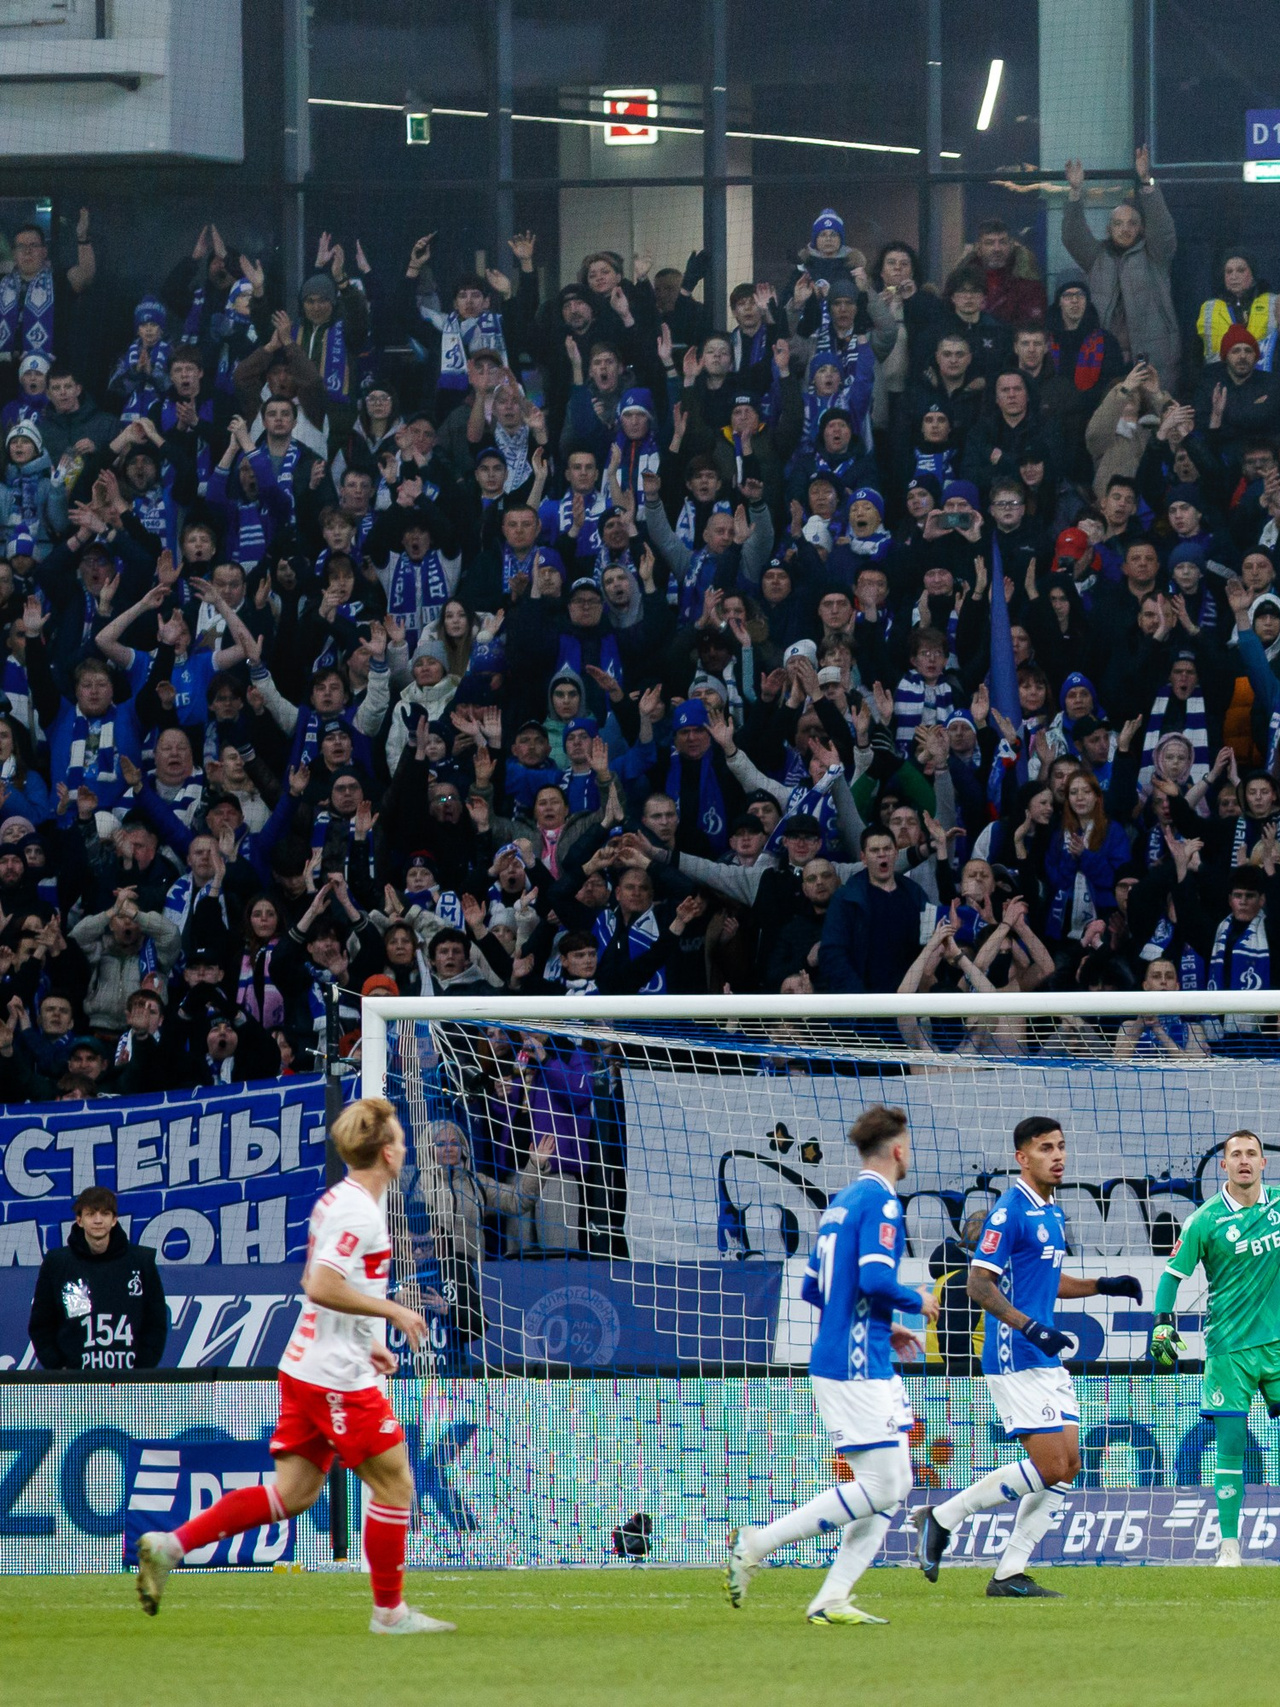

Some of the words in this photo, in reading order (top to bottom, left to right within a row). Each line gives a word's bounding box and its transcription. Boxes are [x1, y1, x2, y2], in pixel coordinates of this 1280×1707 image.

[1252, 123, 1269, 144] D
[80, 1313, 134, 1348] 154
[1063, 1511, 1147, 1553] ВТБ
